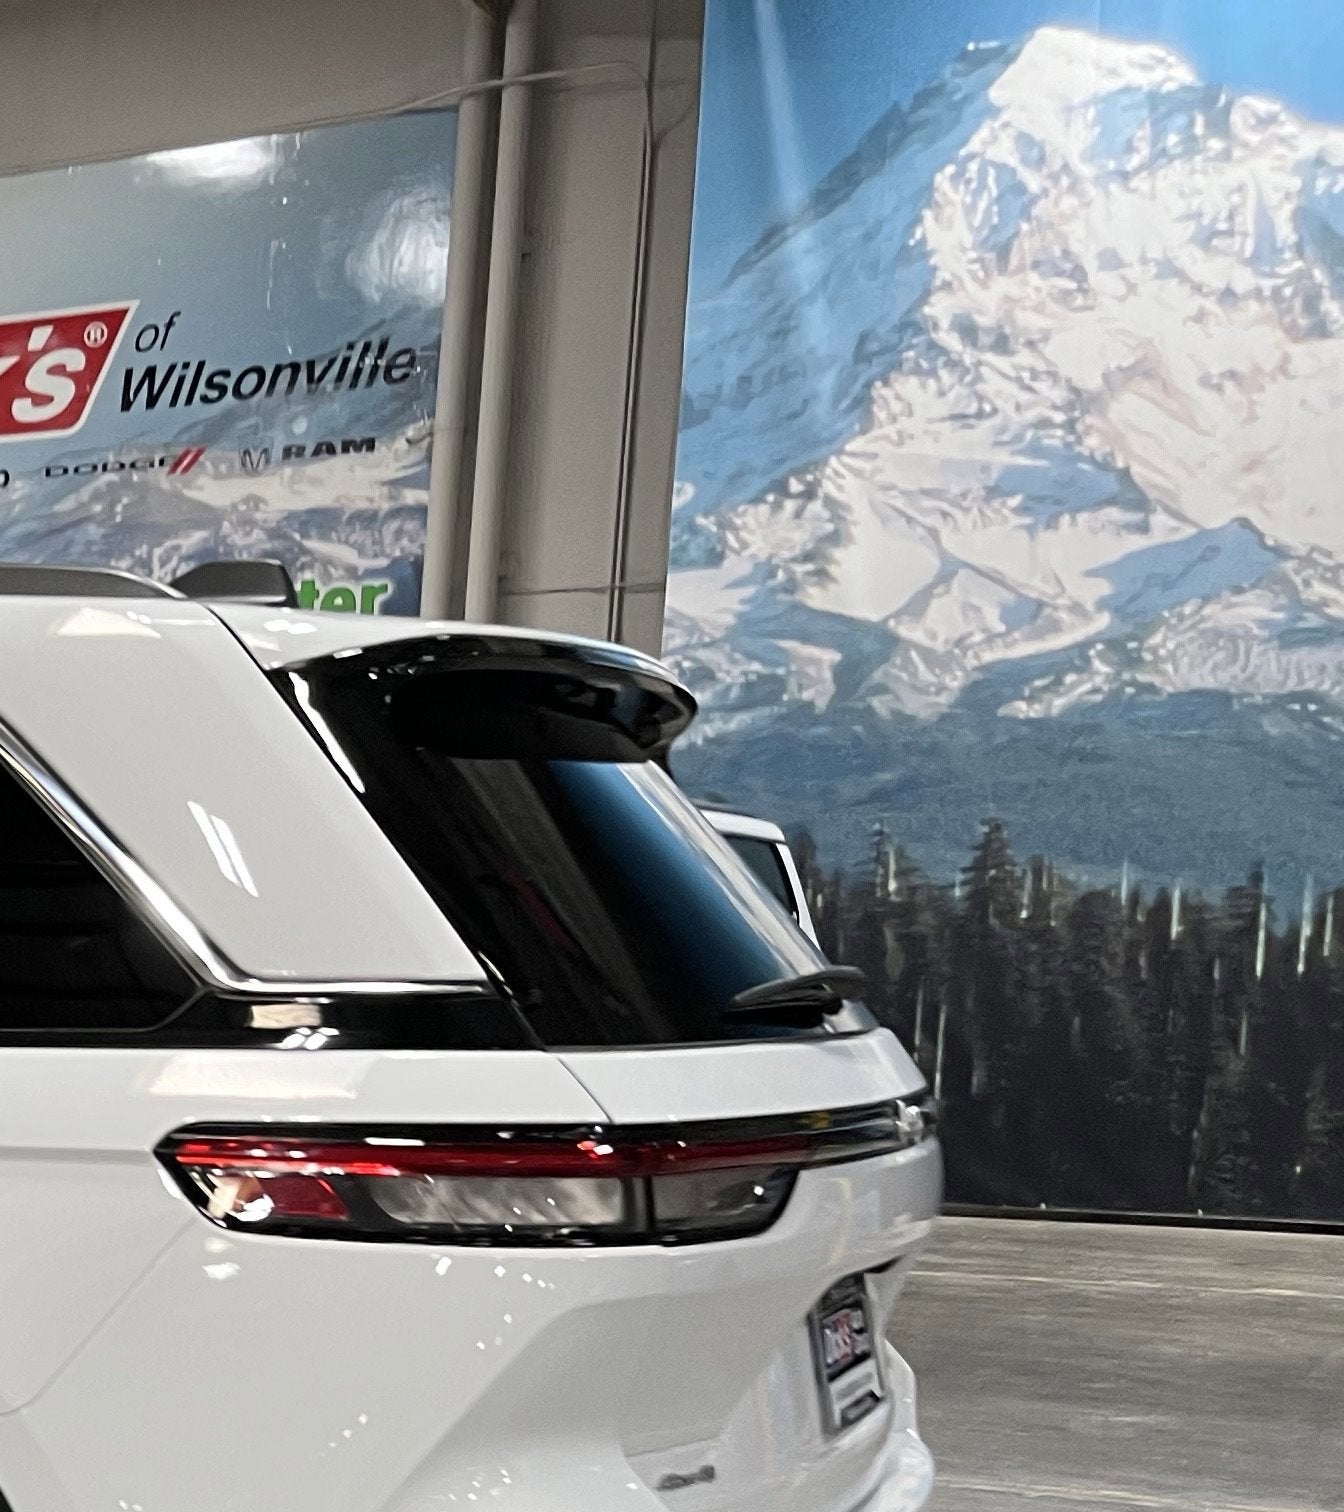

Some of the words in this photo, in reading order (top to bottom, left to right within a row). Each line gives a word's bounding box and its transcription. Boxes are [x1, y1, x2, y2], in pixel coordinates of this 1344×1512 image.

[134, 311, 182, 353] of
[120, 337, 417, 413] Wilsonville
[282, 437, 376, 461] RAM
